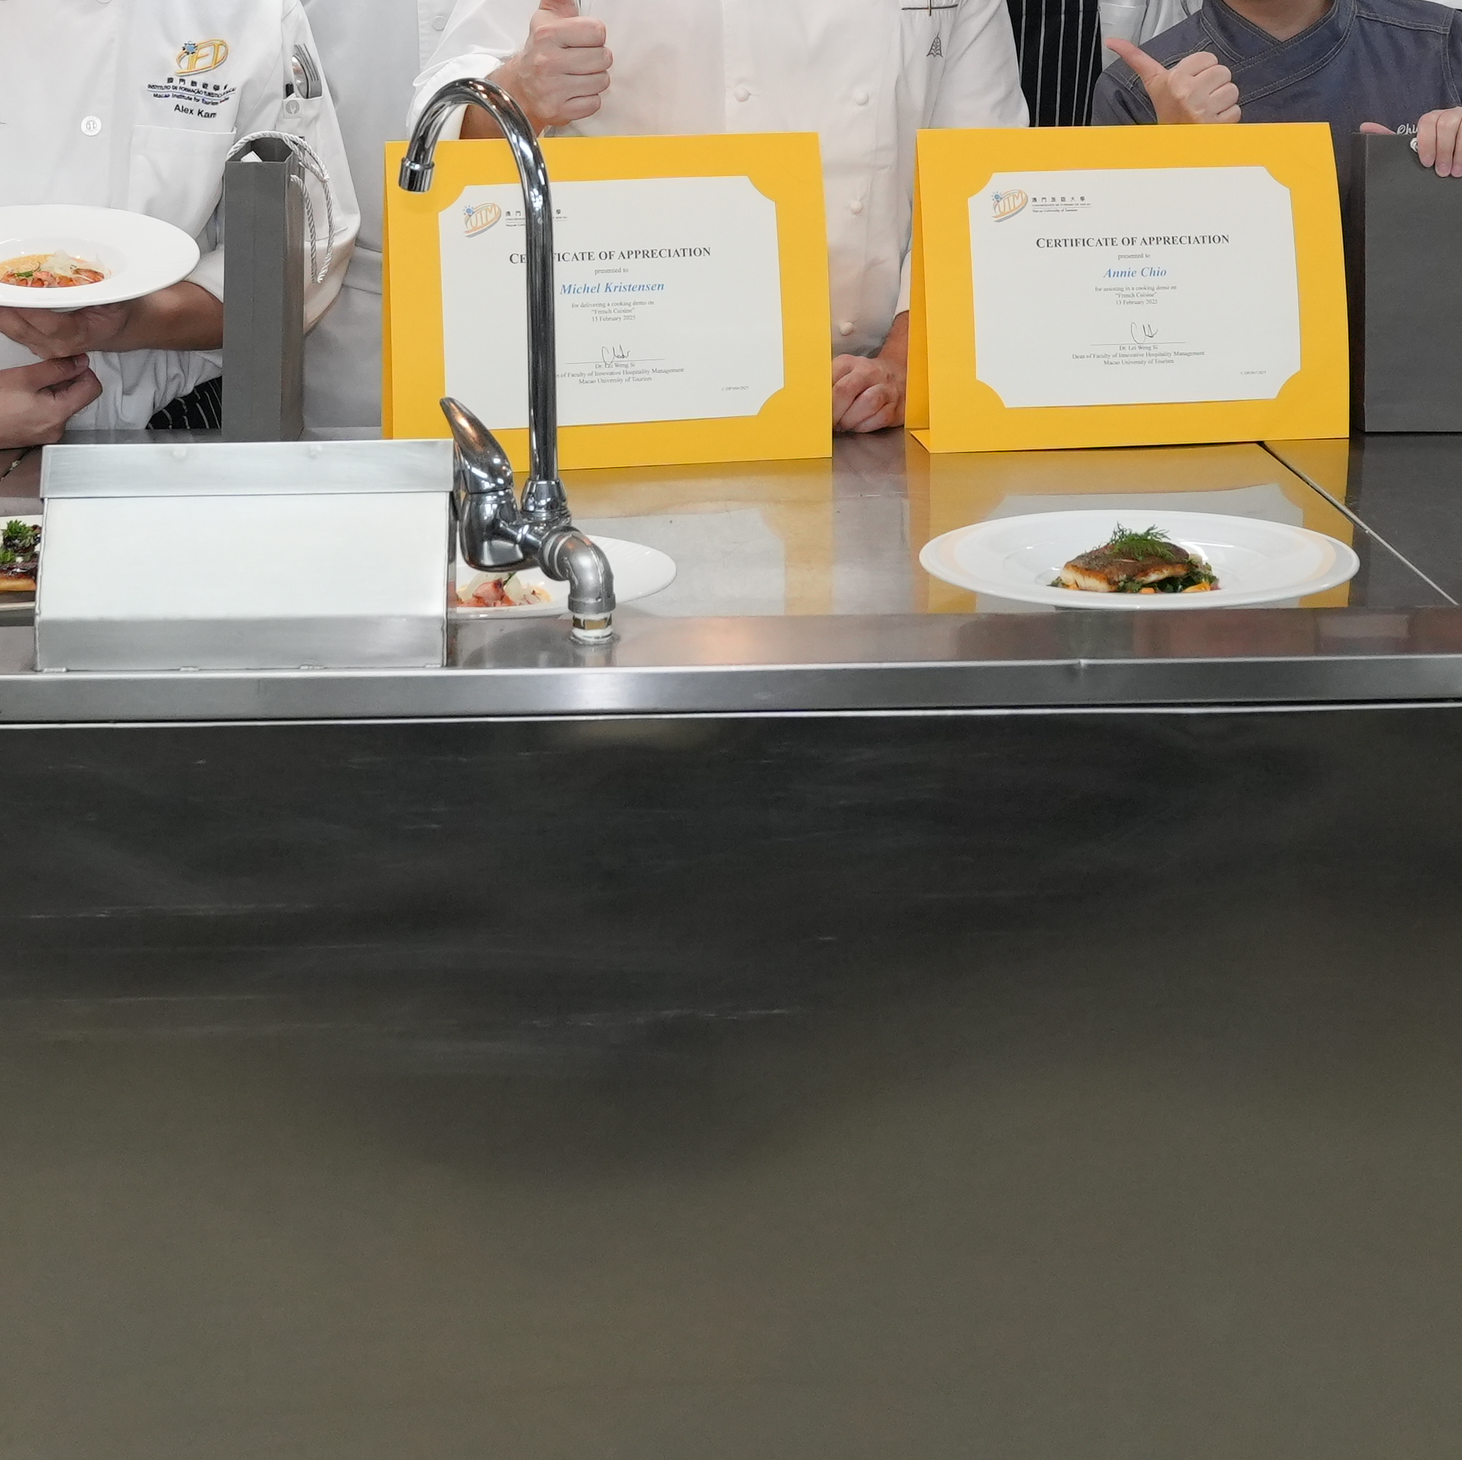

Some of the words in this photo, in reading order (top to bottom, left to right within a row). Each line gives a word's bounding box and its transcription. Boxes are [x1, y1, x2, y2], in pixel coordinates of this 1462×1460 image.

[174, 104, 194, 115] Alex
[1036, 237, 1119, 249] CERTIFICATE
[1121, 236, 1138, 247] OF
[1139, 234, 1230, 246] APPRECIATION
[509, 251, 595, 265] CEICATE
[598, 250, 616, 260] OF
[617, 247, 712, 260] APPRECIATION
[594, 267, 622, 275] presented
[1103, 267, 1137, 279] Annie
[1140, 266, 1167, 278] Chio
[559, 283, 601, 295] Michel
[604, 282, 665, 294] Kristensen
[1122, 299, 1145, 307] February
[598, 315, 622, 323] February
[1092, 352, 1111, 360] Faculty
[1145, 350, 1173, 359] Hospitality
[1173, 350, 1205, 358] Management
[1121, 359, 1147, 367] University
[622, 368, 650, 376] Hospitality
[651, 367, 684, 375] Management
